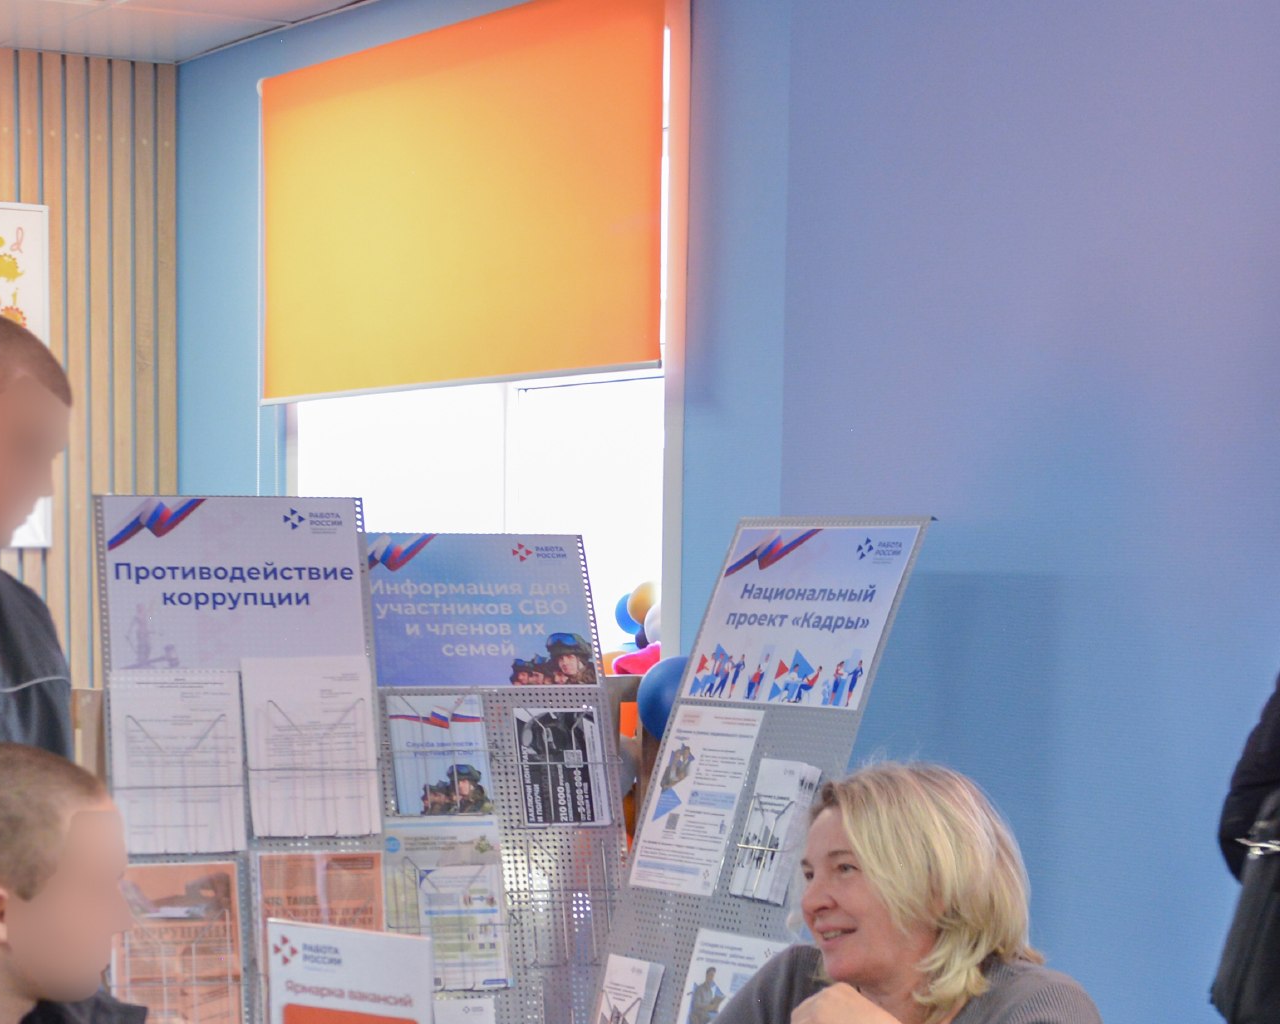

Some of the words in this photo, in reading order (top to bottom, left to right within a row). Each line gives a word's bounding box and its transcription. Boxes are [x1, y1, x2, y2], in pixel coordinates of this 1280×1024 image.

[114, 561, 354, 584] Противодействие
[369, 579, 523, 598] Информация
[528, 583, 570, 596] для
[740, 583, 877, 602] Национальный
[162, 591, 310, 610] коррупции
[376, 602, 513, 620] участников
[518, 599, 568, 616] СВО
[405, 623, 420, 635] и
[427, 623, 512, 636] членов
[519, 622, 546, 635] их
[726, 612, 788, 630] проект
[791, 612, 870, 633] «Кадры»
[442, 640, 516, 657] семей
[525, 785, 536, 822] ЗАКЛЮЧИ
[533, 784, 543, 815] ПОЛУЧИ
[557, 786, 567, 805] 000
[560, 806, 569, 822] 210
[302, 943, 340, 955] РАБОТА
[302, 954, 342, 966] РОССИИ
[285, 979, 345, 999] Ярмарка
[348, 988, 413, 1008] вакансий
